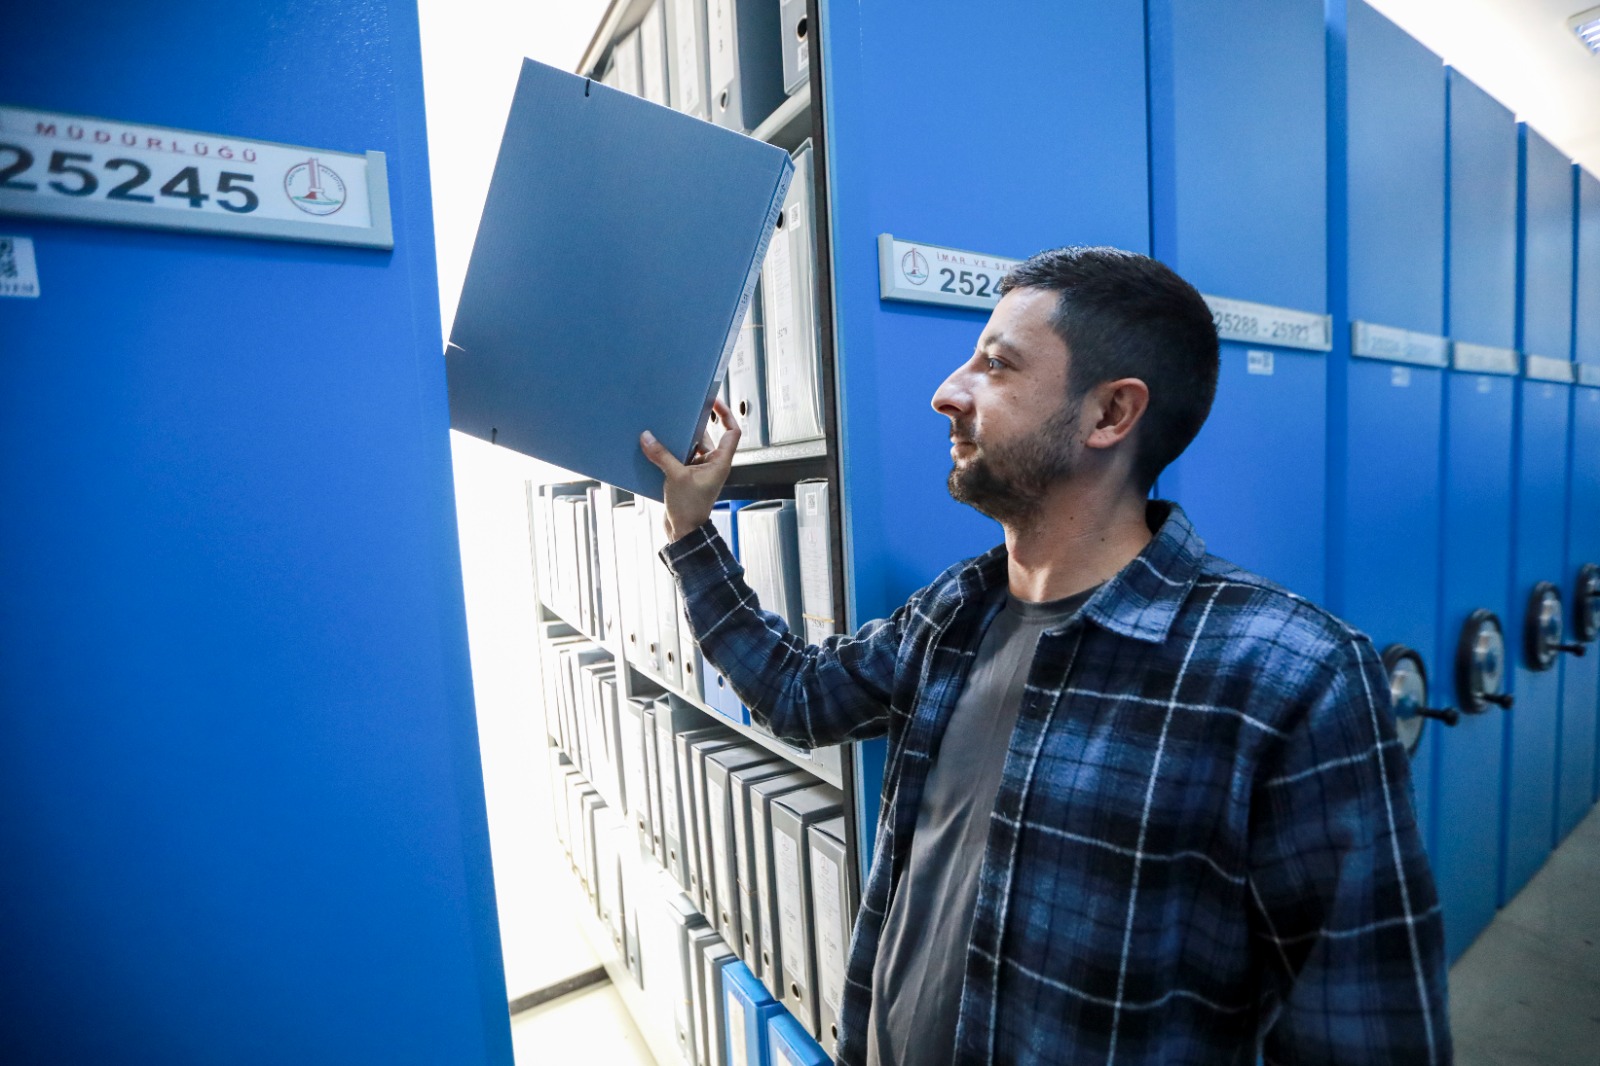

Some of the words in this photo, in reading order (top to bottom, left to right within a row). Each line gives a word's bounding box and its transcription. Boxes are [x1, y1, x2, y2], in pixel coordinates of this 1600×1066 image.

[35, 121, 257, 163] MÜDÜRLÜĞÜ
[0, 144, 260, 214] 25245
[937, 251, 965, 264] İMAR
[974, 260, 987, 268] VE
